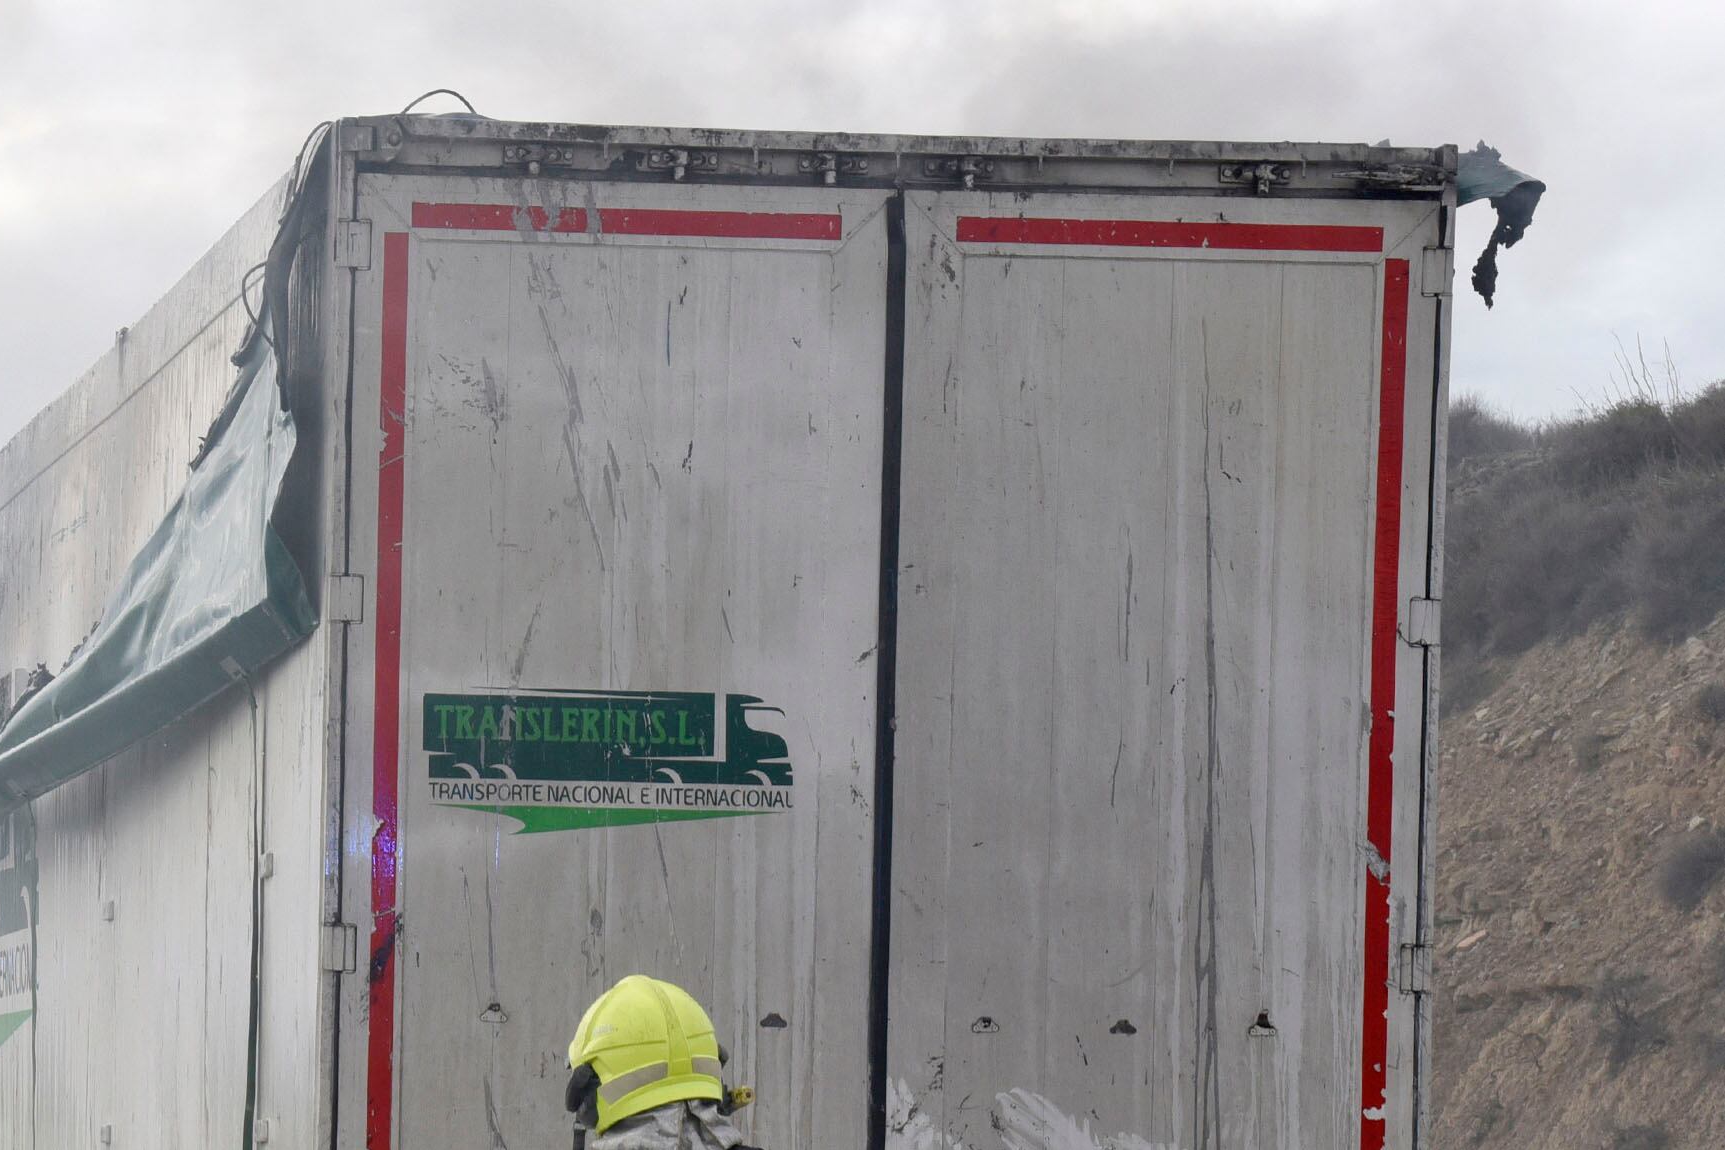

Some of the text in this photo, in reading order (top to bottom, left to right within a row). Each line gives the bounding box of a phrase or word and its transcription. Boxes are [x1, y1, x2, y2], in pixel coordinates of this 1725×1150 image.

[429, 781, 793, 808] TRANSPORTE NACIONAL E INTERNACIONAL
